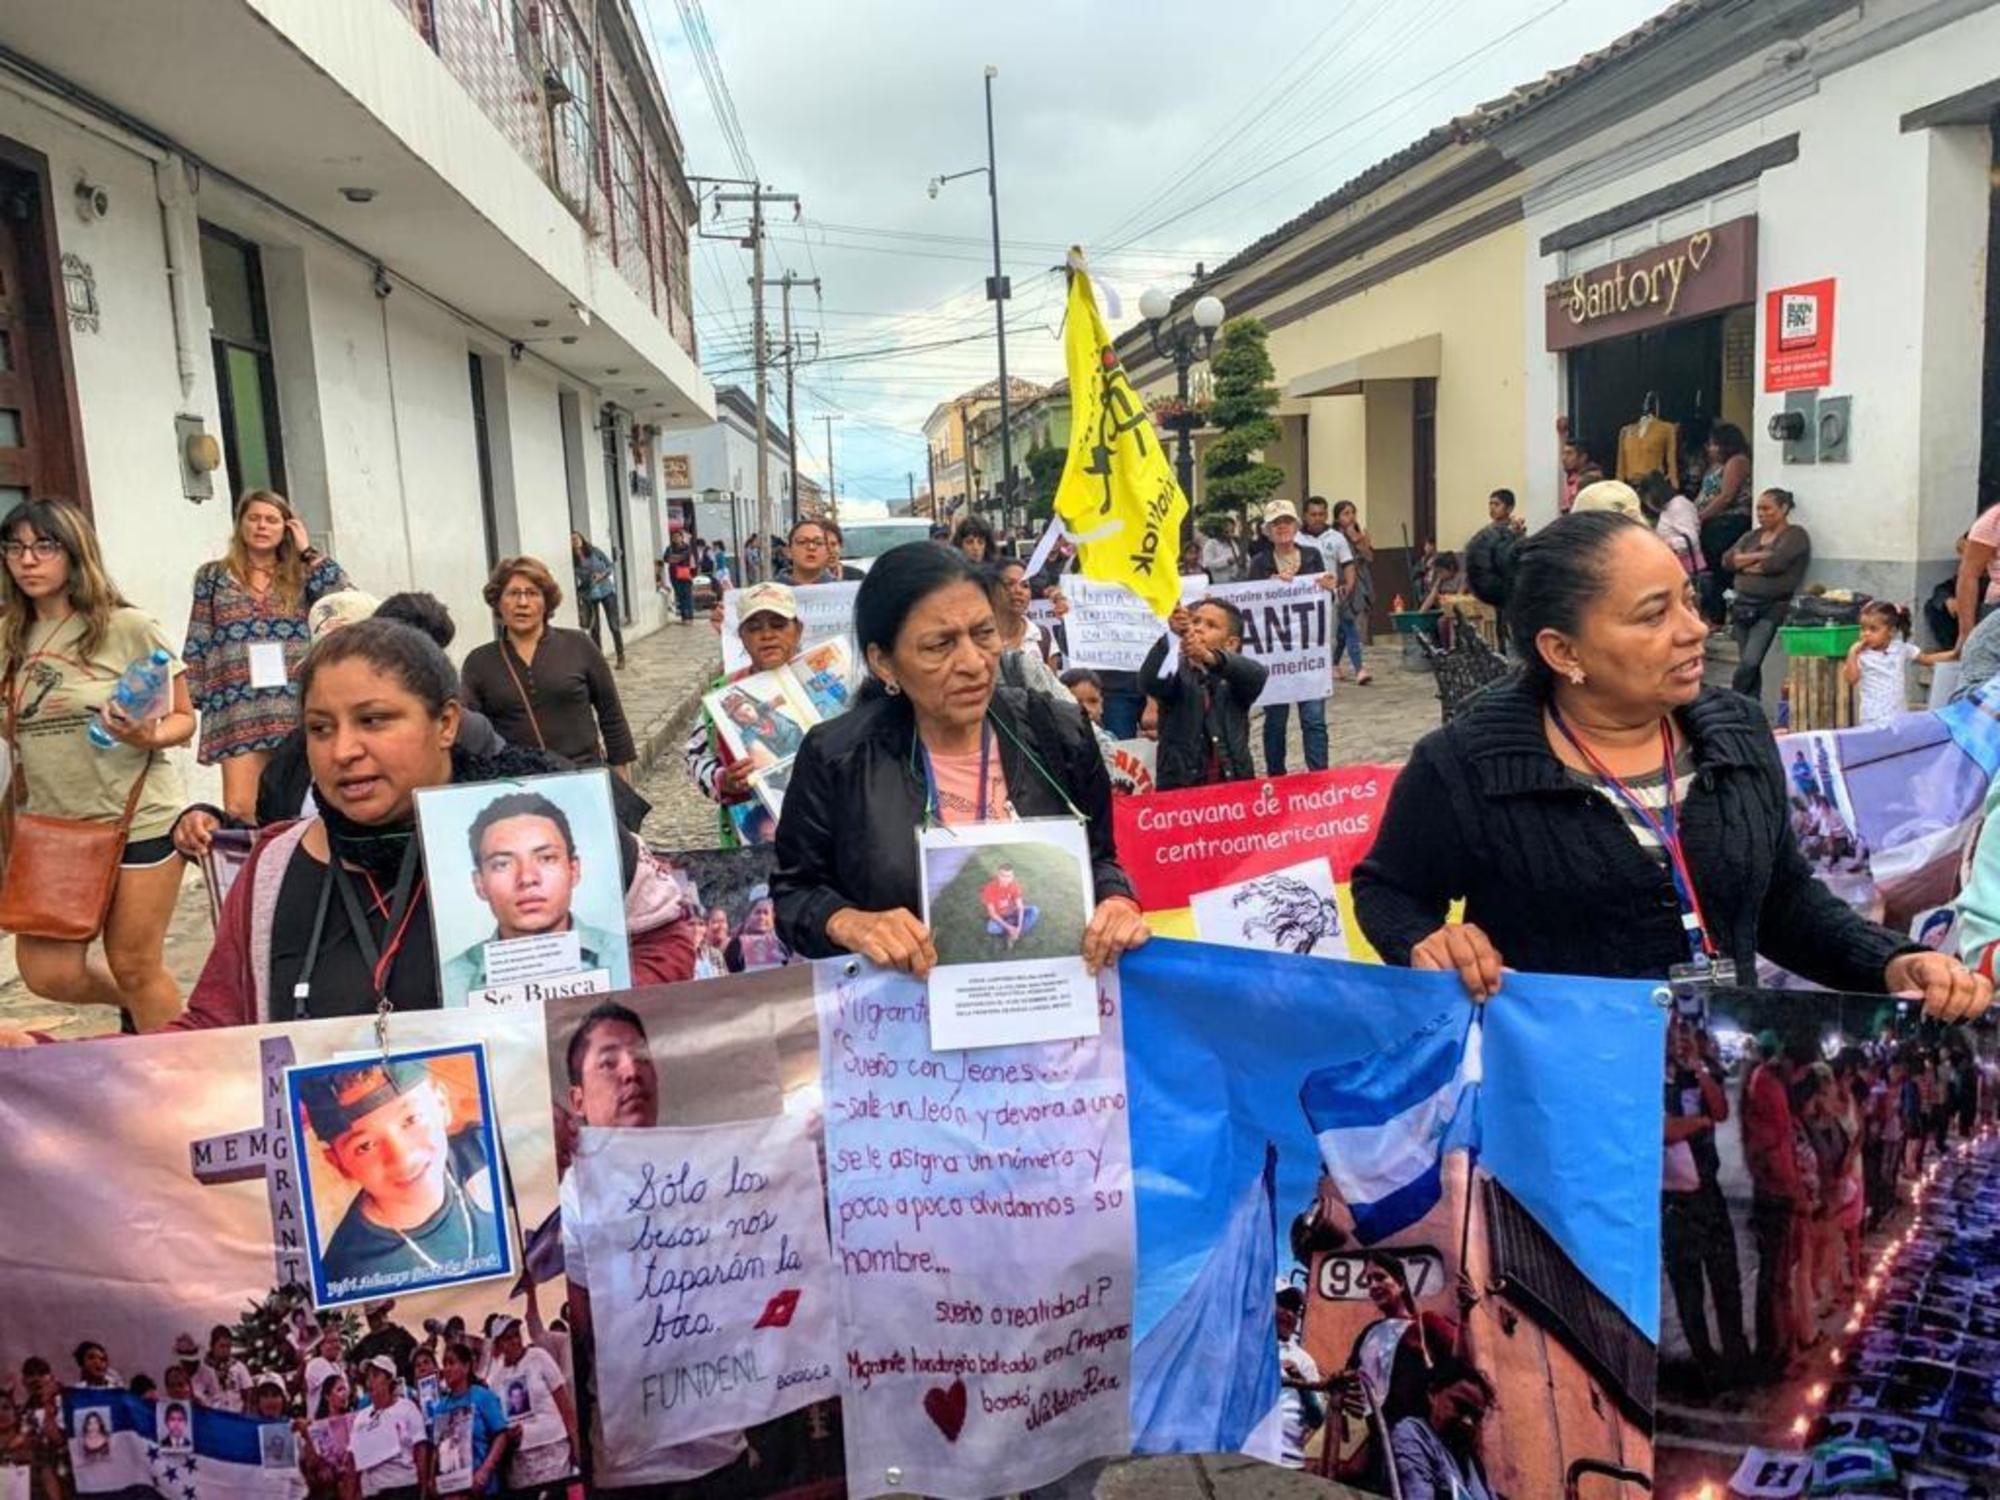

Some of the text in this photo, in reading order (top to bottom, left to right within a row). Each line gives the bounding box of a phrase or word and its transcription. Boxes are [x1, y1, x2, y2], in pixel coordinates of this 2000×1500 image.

[1568, 252, 1685, 325] Santory
[1241, 599, 1326, 655] ANTI
[1137, 779, 1378, 832] Caravana de madres
[1155, 813, 1371, 865] centroamericanas
[524, 979, 596, 1002] Busca
[836, 982, 930, 1041] Migrant
[908, 1059, 947, 1079] con
[977, 1109, 996, 1141] y
[995, 1102, 1066, 1127] devora
[1073, 1098, 1087, 1115] a
[1091, 1092, 1126, 1112] uno
[268, 1077, 300, 1284] MIGRANT
[627, 1155, 770, 1214] Sólo los
[889, 1146, 959, 1184] asigna
[967, 1152, 993, 1171] un
[999, 1146, 1074, 1169] número
[1081, 1147, 1103, 1183] y
[627, 1209, 779, 1252] besos nos
[839, 1189, 1123, 1240] poco a poco olvidamos su
[634, 1234, 803, 1308] taparán la
[935, 1299, 984, 1325] sueño
[991, 1309, 1004, 1326] o
[847, 1348, 906, 1391] Migrante
[977, 1350, 1037, 1376] baleado
[1043, 1346, 1065, 1365] en
